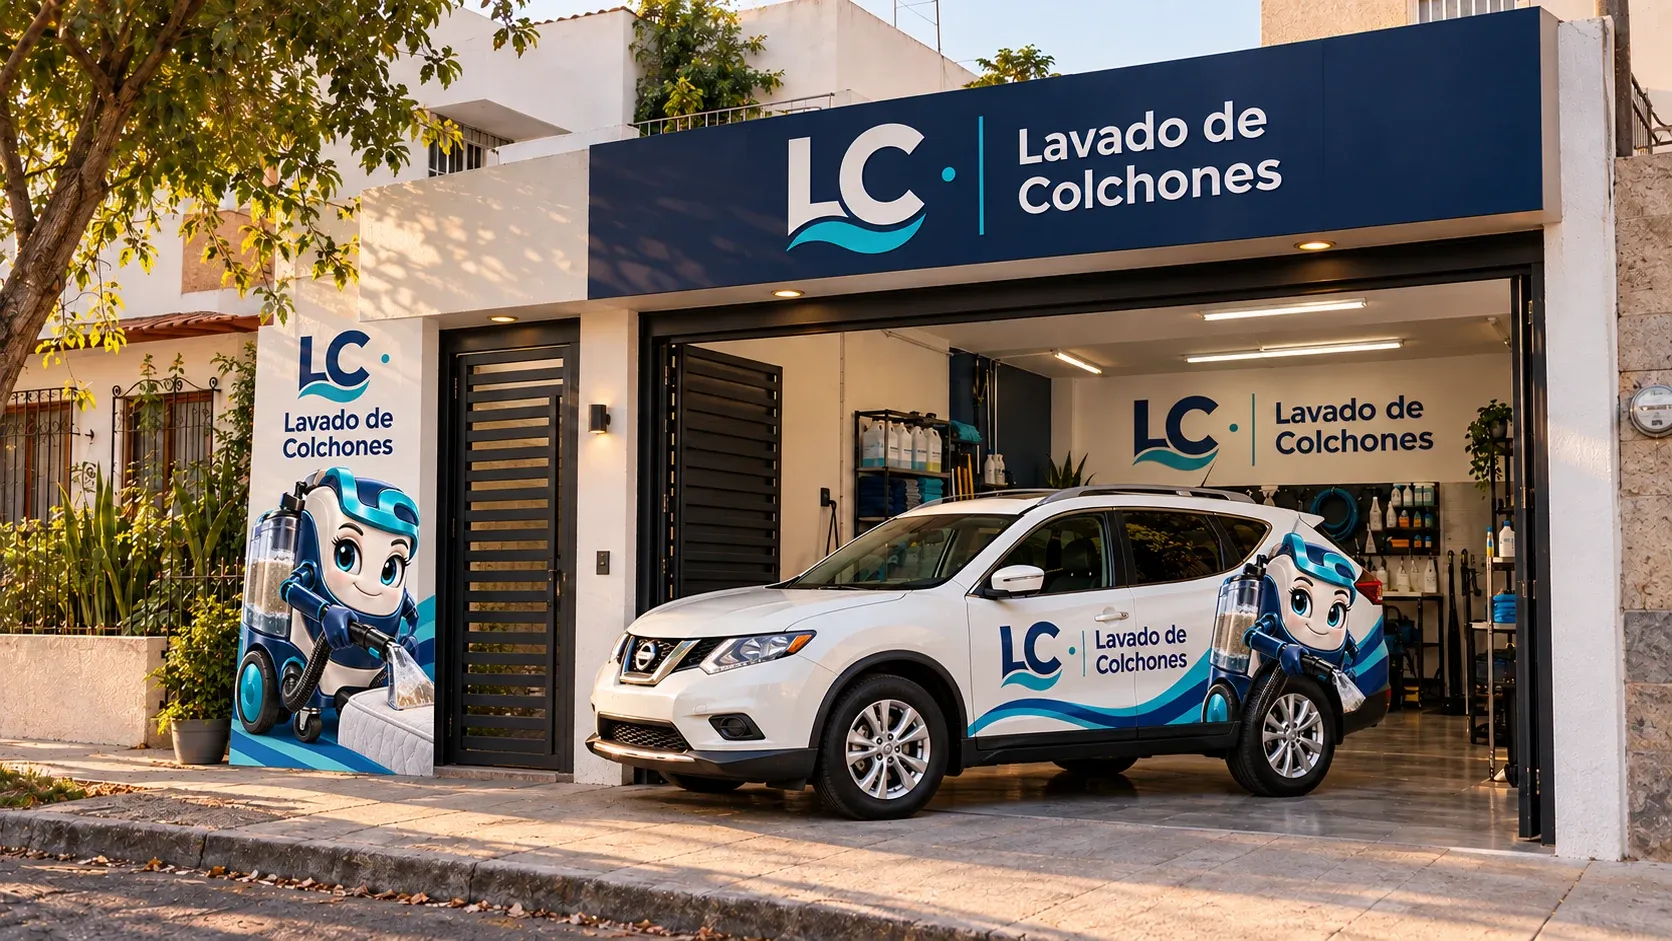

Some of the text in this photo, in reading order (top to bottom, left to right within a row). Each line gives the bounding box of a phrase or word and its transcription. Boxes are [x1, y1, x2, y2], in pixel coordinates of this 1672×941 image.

[1018, 100, 1268, 165] Lavado de
[787, 123, 925, 237] LC
[1018, 159, 1283, 215] Colchones
[299, 330, 371, 391] LC
[284, 407, 394, 432] Lavado de
[1133, 395, 1219, 457] LC
[1275, 395, 1424, 425] Lavado de
[282, 436, 394, 458] Colchones
[1275, 429, 1434, 455] Colchones
[1000, 621, 1062, 680] LC
[1095, 624, 1187, 650] Lavado de
[1096, 652, 1188, 675] Colchones
